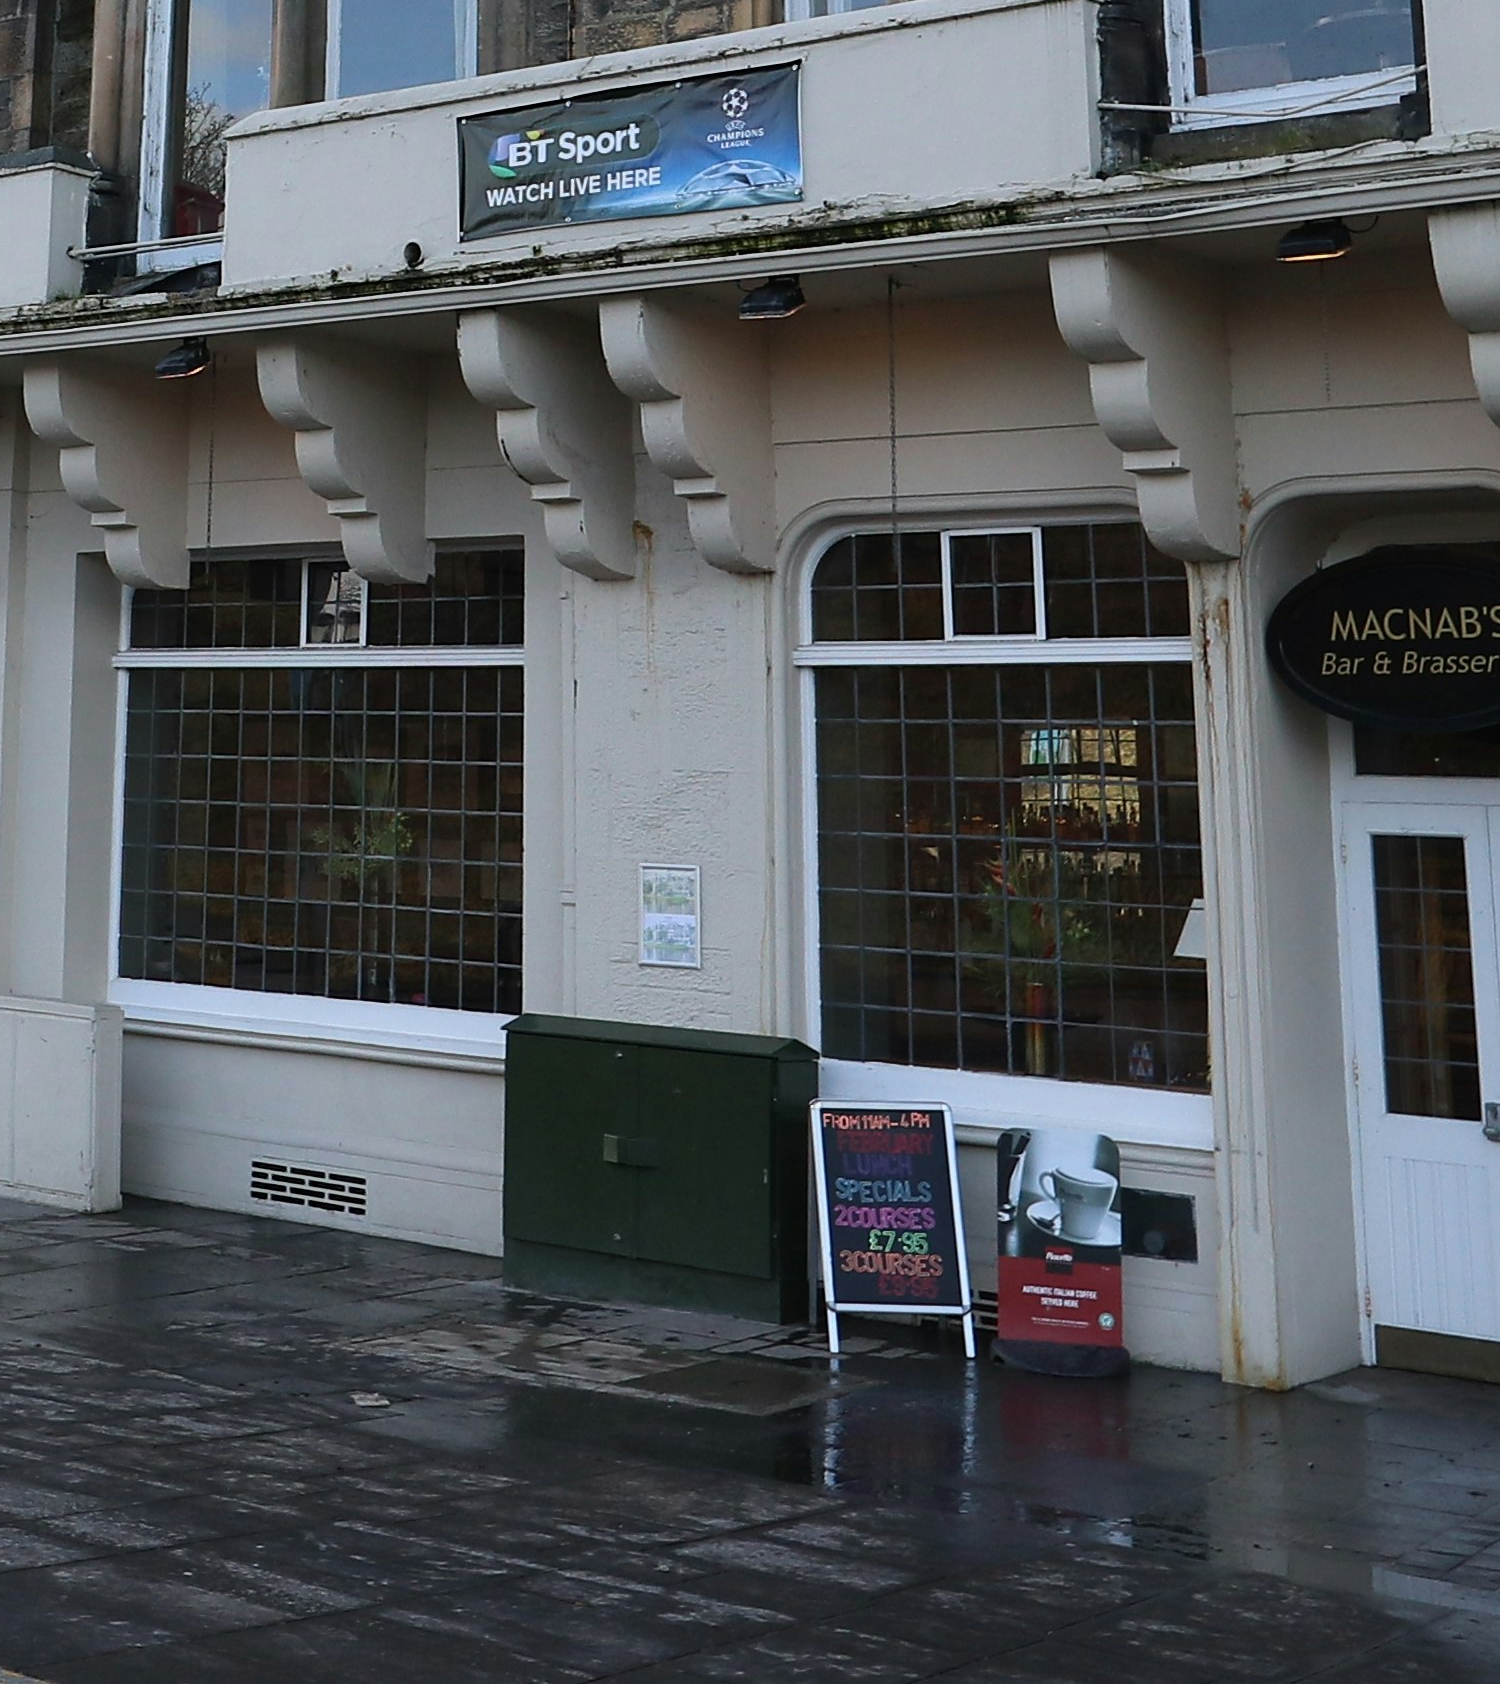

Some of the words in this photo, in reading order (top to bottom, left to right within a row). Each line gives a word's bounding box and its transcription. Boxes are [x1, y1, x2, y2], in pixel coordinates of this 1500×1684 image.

[508, 138, 554, 167] BT
[558, 123, 640, 164] Sport
[706, 127, 765, 143] CHAMPIONS
[720, 139, 751, 149] LEAGUE
[486, 183, 553, 208] WATCH
[559, 174, 601, 198] LIVE
[607, 166, 661, 191] HERE
[1321, 652, 1364, 675] Bar
[1373, 651, 1392, 675] &
[822, 1113, 860, 1130] FROM
[837, 1131, 934, 1154] FEBRUARY
[843, 1153, 913, 1175] LUNCH
[834, 1177, 933, 1203] SPECIALS
[1022, 1285, 1053, 1296] AUTHENTIC
[1076, 1290, 1097, 1300] COFFEE
[1041, 1296, 1063, 1307] SERVED
[1064, 1299, 1080, 1309] HERE
